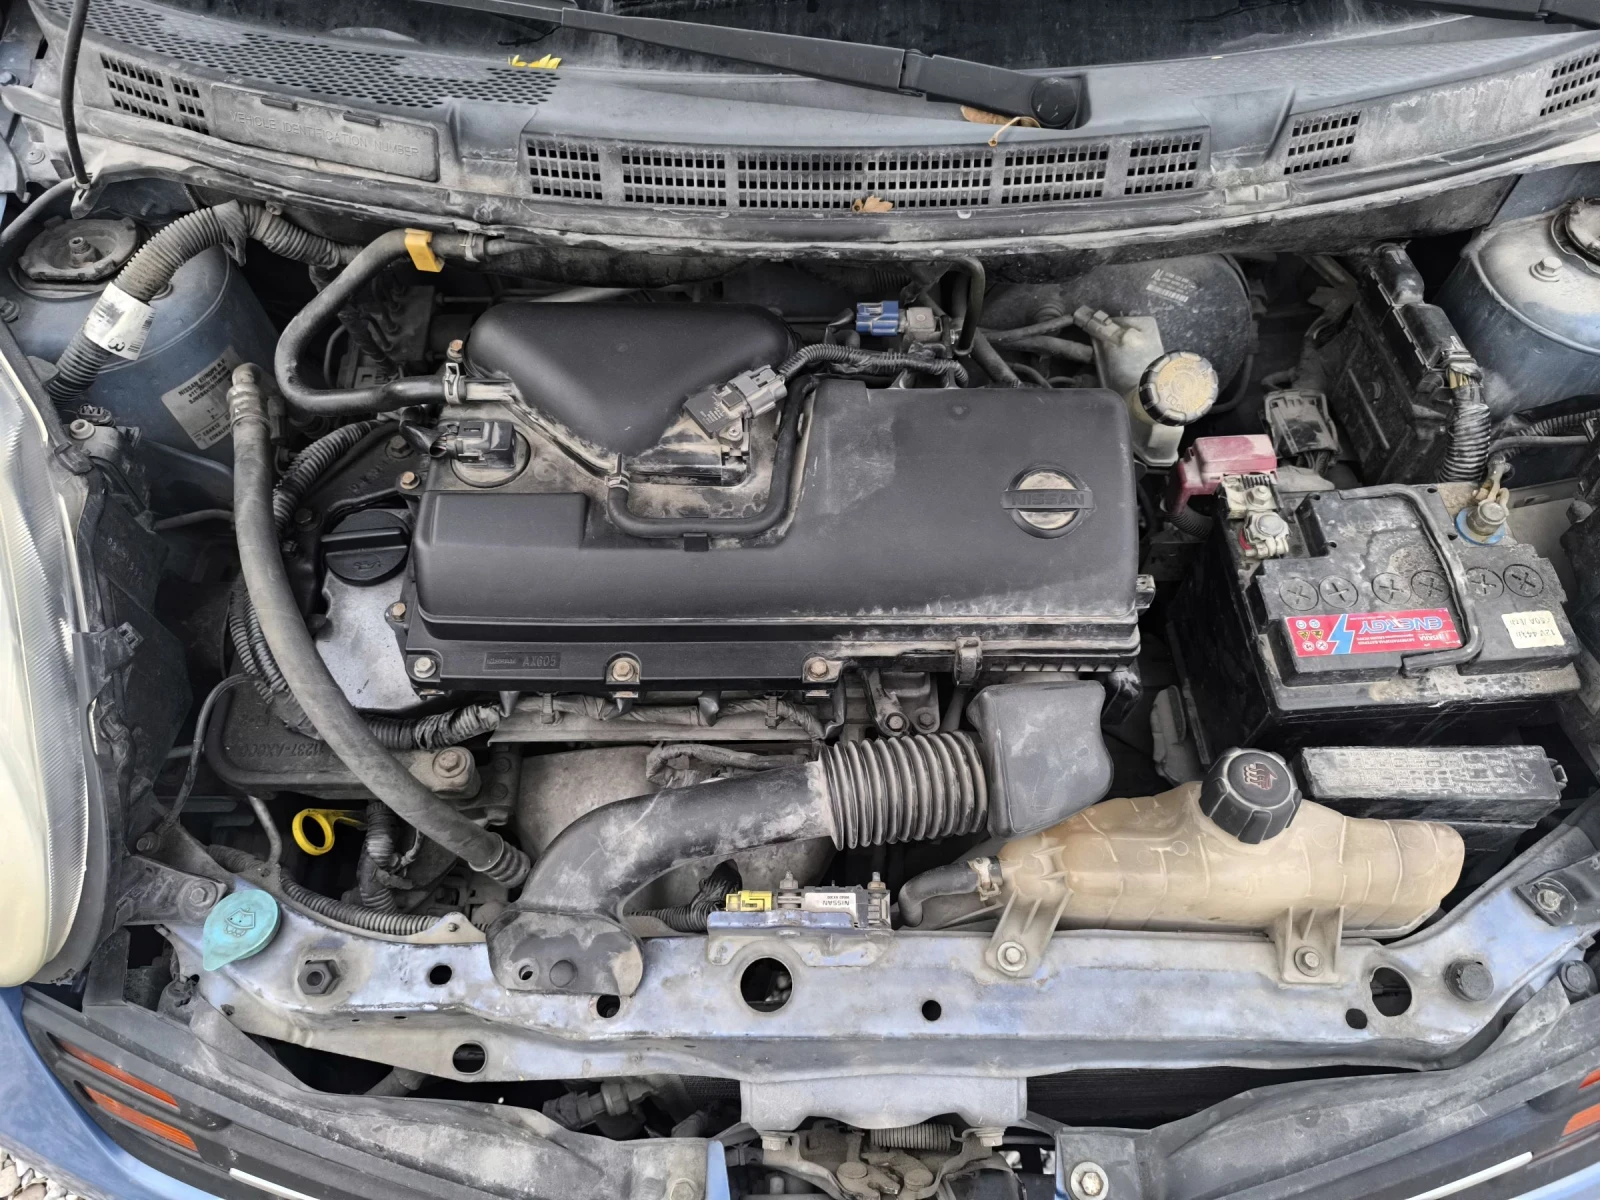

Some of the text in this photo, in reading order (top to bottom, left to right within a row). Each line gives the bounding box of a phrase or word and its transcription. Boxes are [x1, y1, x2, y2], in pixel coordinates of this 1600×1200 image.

[230, 110, 420, 157] VEHICLE IDENTIFICATION NUMBER
[178, 380, 200, 397] NISSAN
[198, 366, 218, 385] EUROPE
[1011, 492, 1085, 506] NISSAN
[1359, 616, 1442, 634] ENERGY
